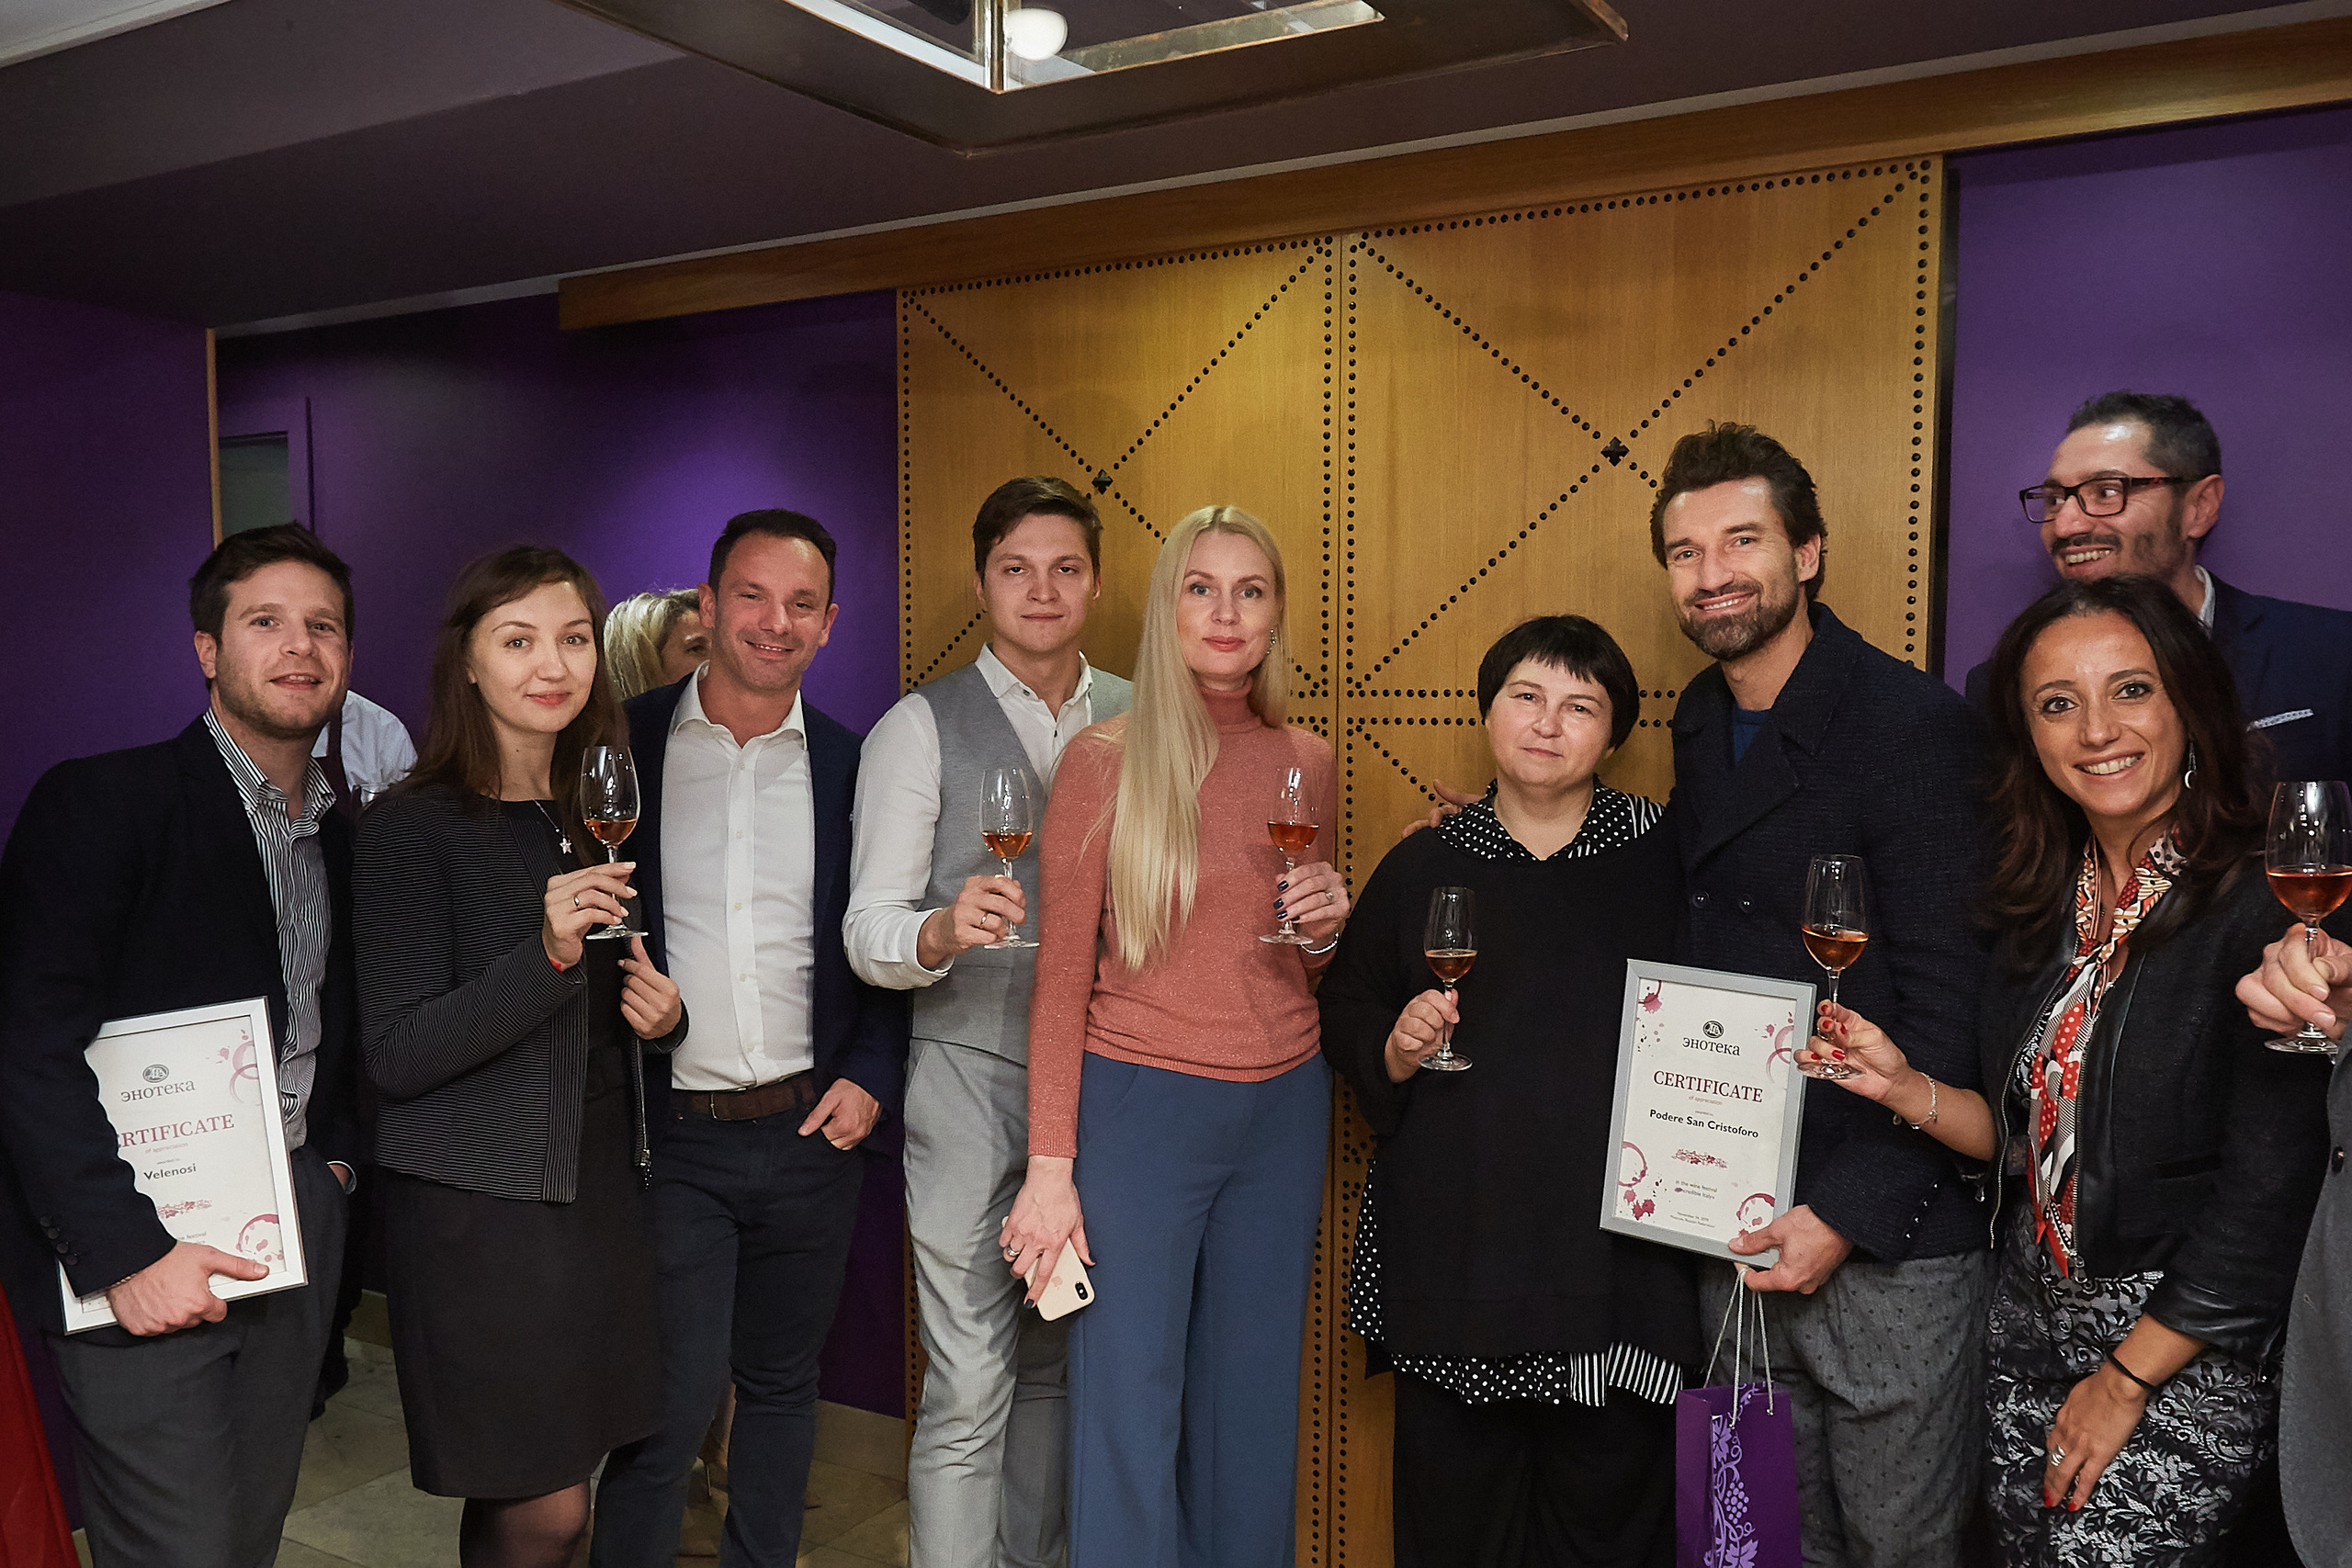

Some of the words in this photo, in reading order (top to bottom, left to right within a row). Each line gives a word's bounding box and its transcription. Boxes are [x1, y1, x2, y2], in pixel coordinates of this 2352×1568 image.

[1653, 1070, 1763, 1102] CERTIFICATE
[118, 1114, 234, 1148] RTIFICATE
[1649, 1109, 1684, 1123] Podere
[1686, 1115, 1704, 1127] San
[1707, 1120, 1759, 1138] Cristoforo
[143, 1162, 197, 1180] Velenosi
